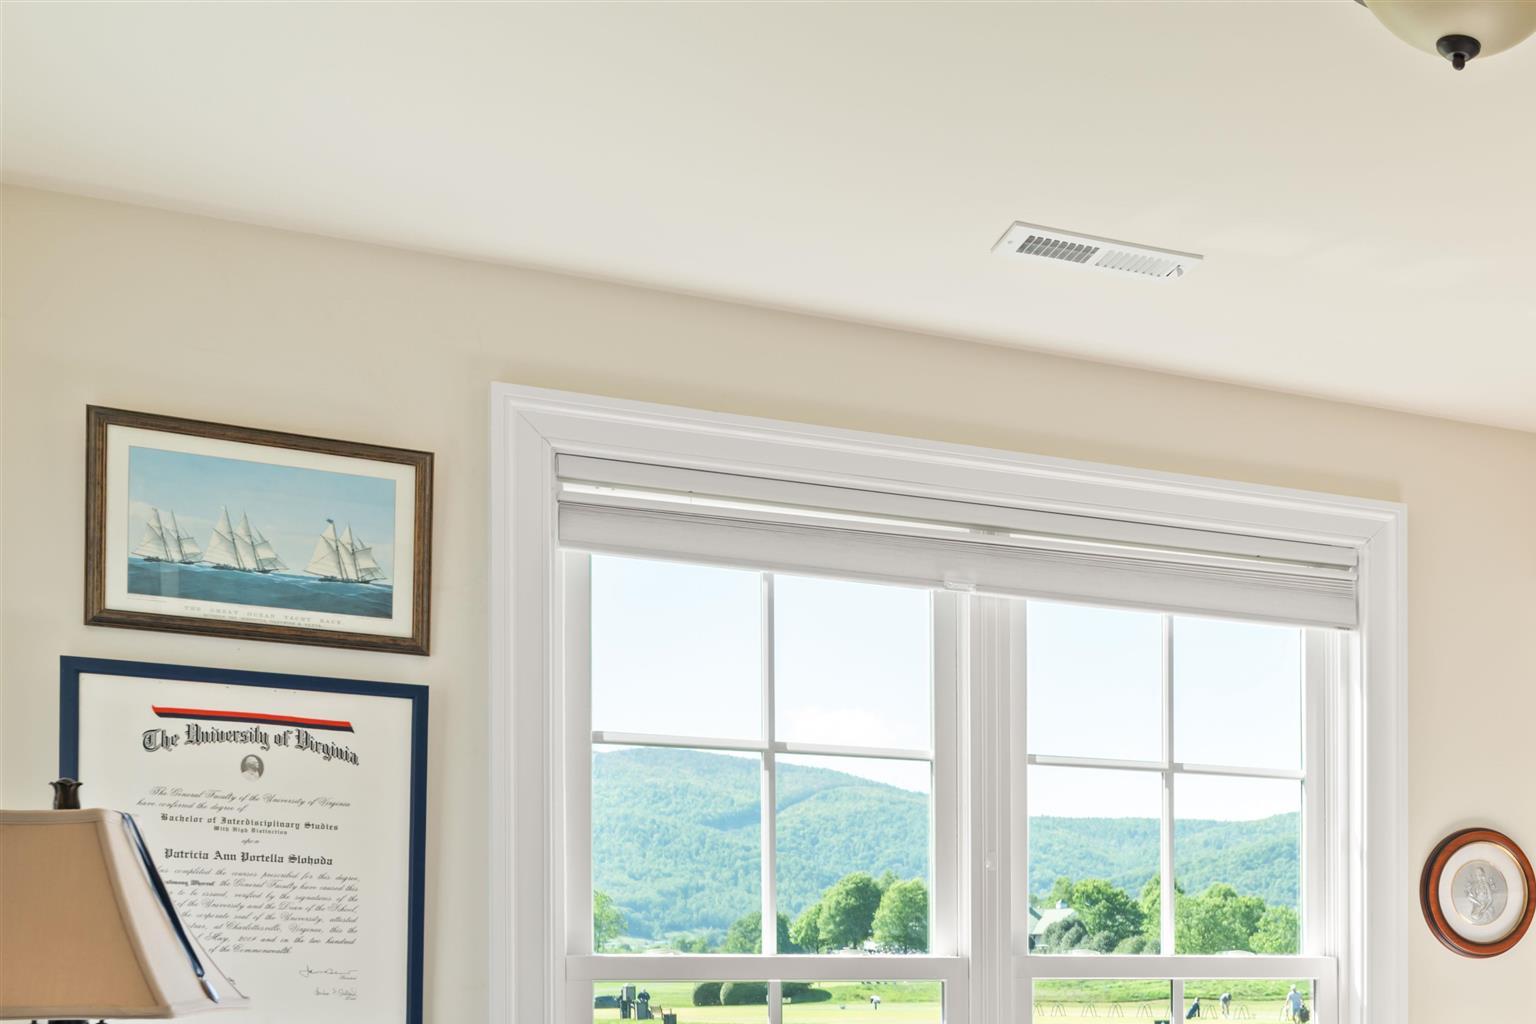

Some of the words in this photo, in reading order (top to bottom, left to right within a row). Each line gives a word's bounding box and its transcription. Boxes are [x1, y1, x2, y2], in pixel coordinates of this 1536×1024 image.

[142, 728, 179, 752] The
[185, 723, 270, 751] University
[274, 730, 293, 748] of
[161, 813, 203, 823] Bachelor
[221, 817, 300, 830] Interdisciplinary
[304, 822, 339, 831] Studies
[165, 848, 208, 860] Patricia
[213, 851, 237, 861] Ann
[241, 852, 284, 863] Portella
